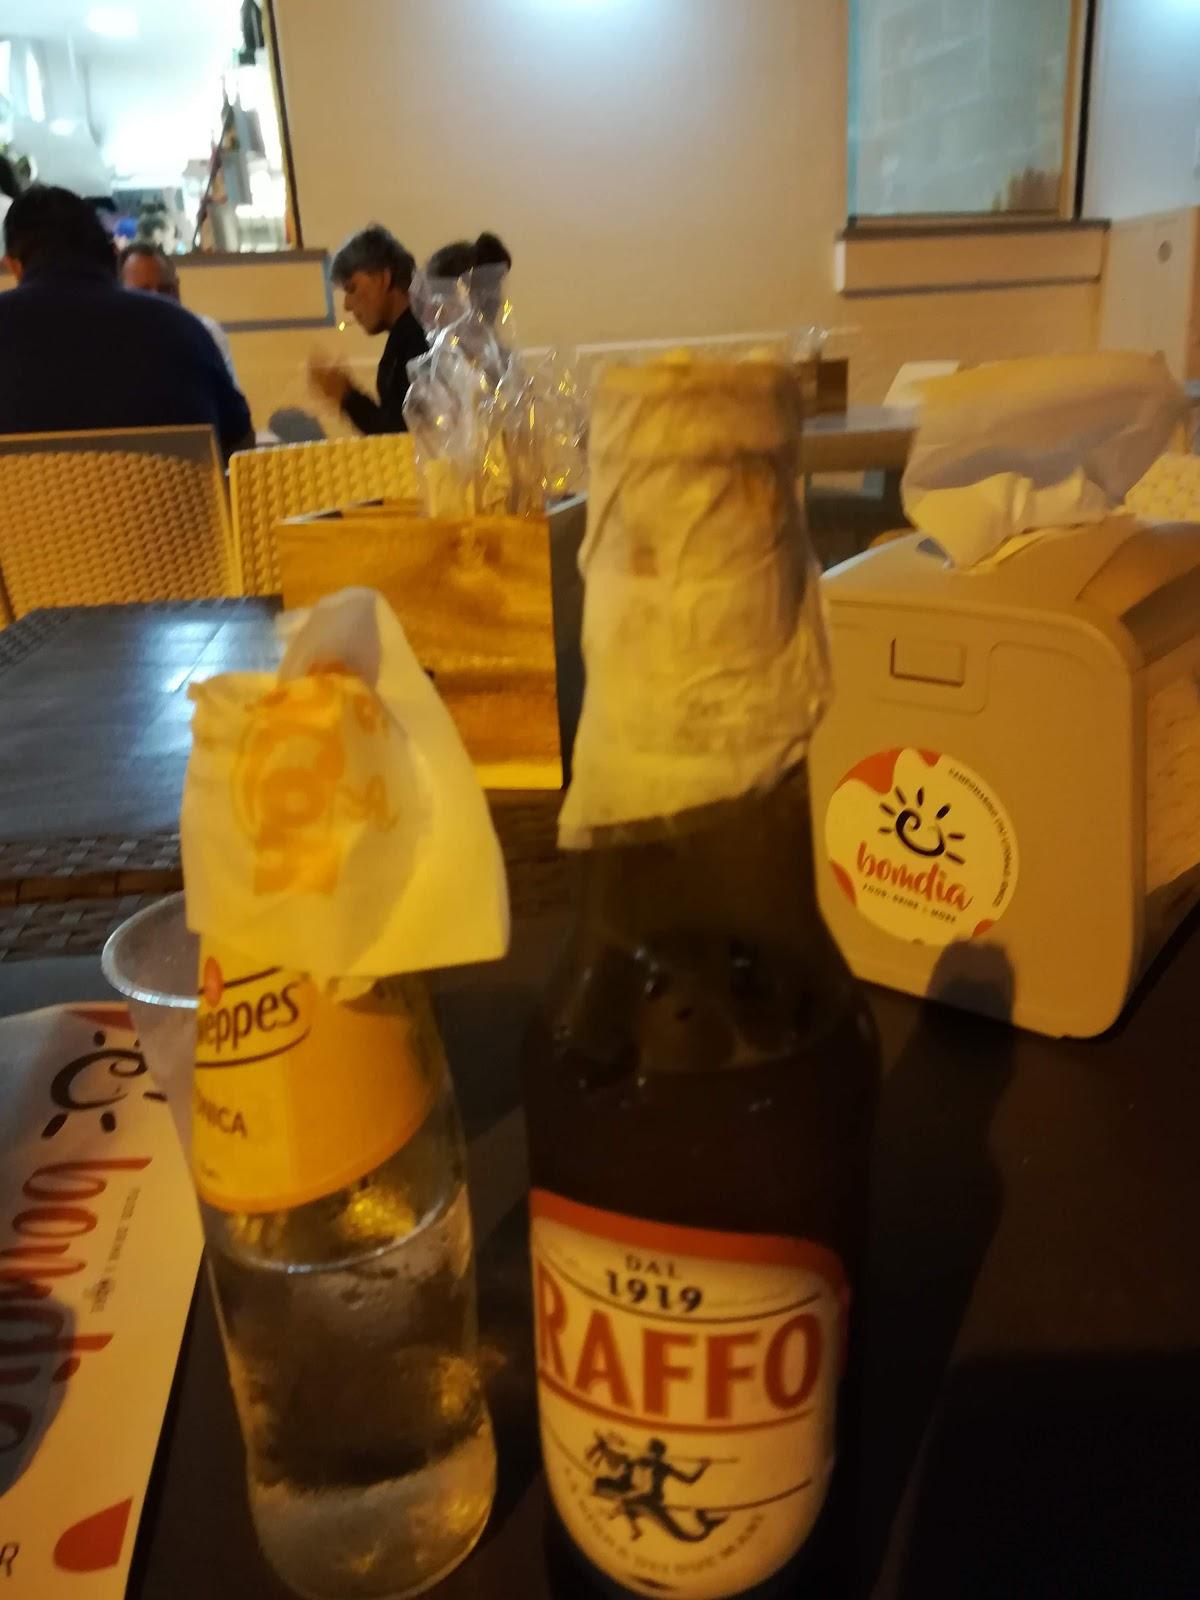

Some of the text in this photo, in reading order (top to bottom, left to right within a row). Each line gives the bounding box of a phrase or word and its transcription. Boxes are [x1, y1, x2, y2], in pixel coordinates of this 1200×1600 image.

[855, 840, 974, 911] bomdia
[605, 1270, 703, 1313] 1919
[626, 1254, 681, 1280] DAL
[537, 1260, 822, 1421] RAFFO
